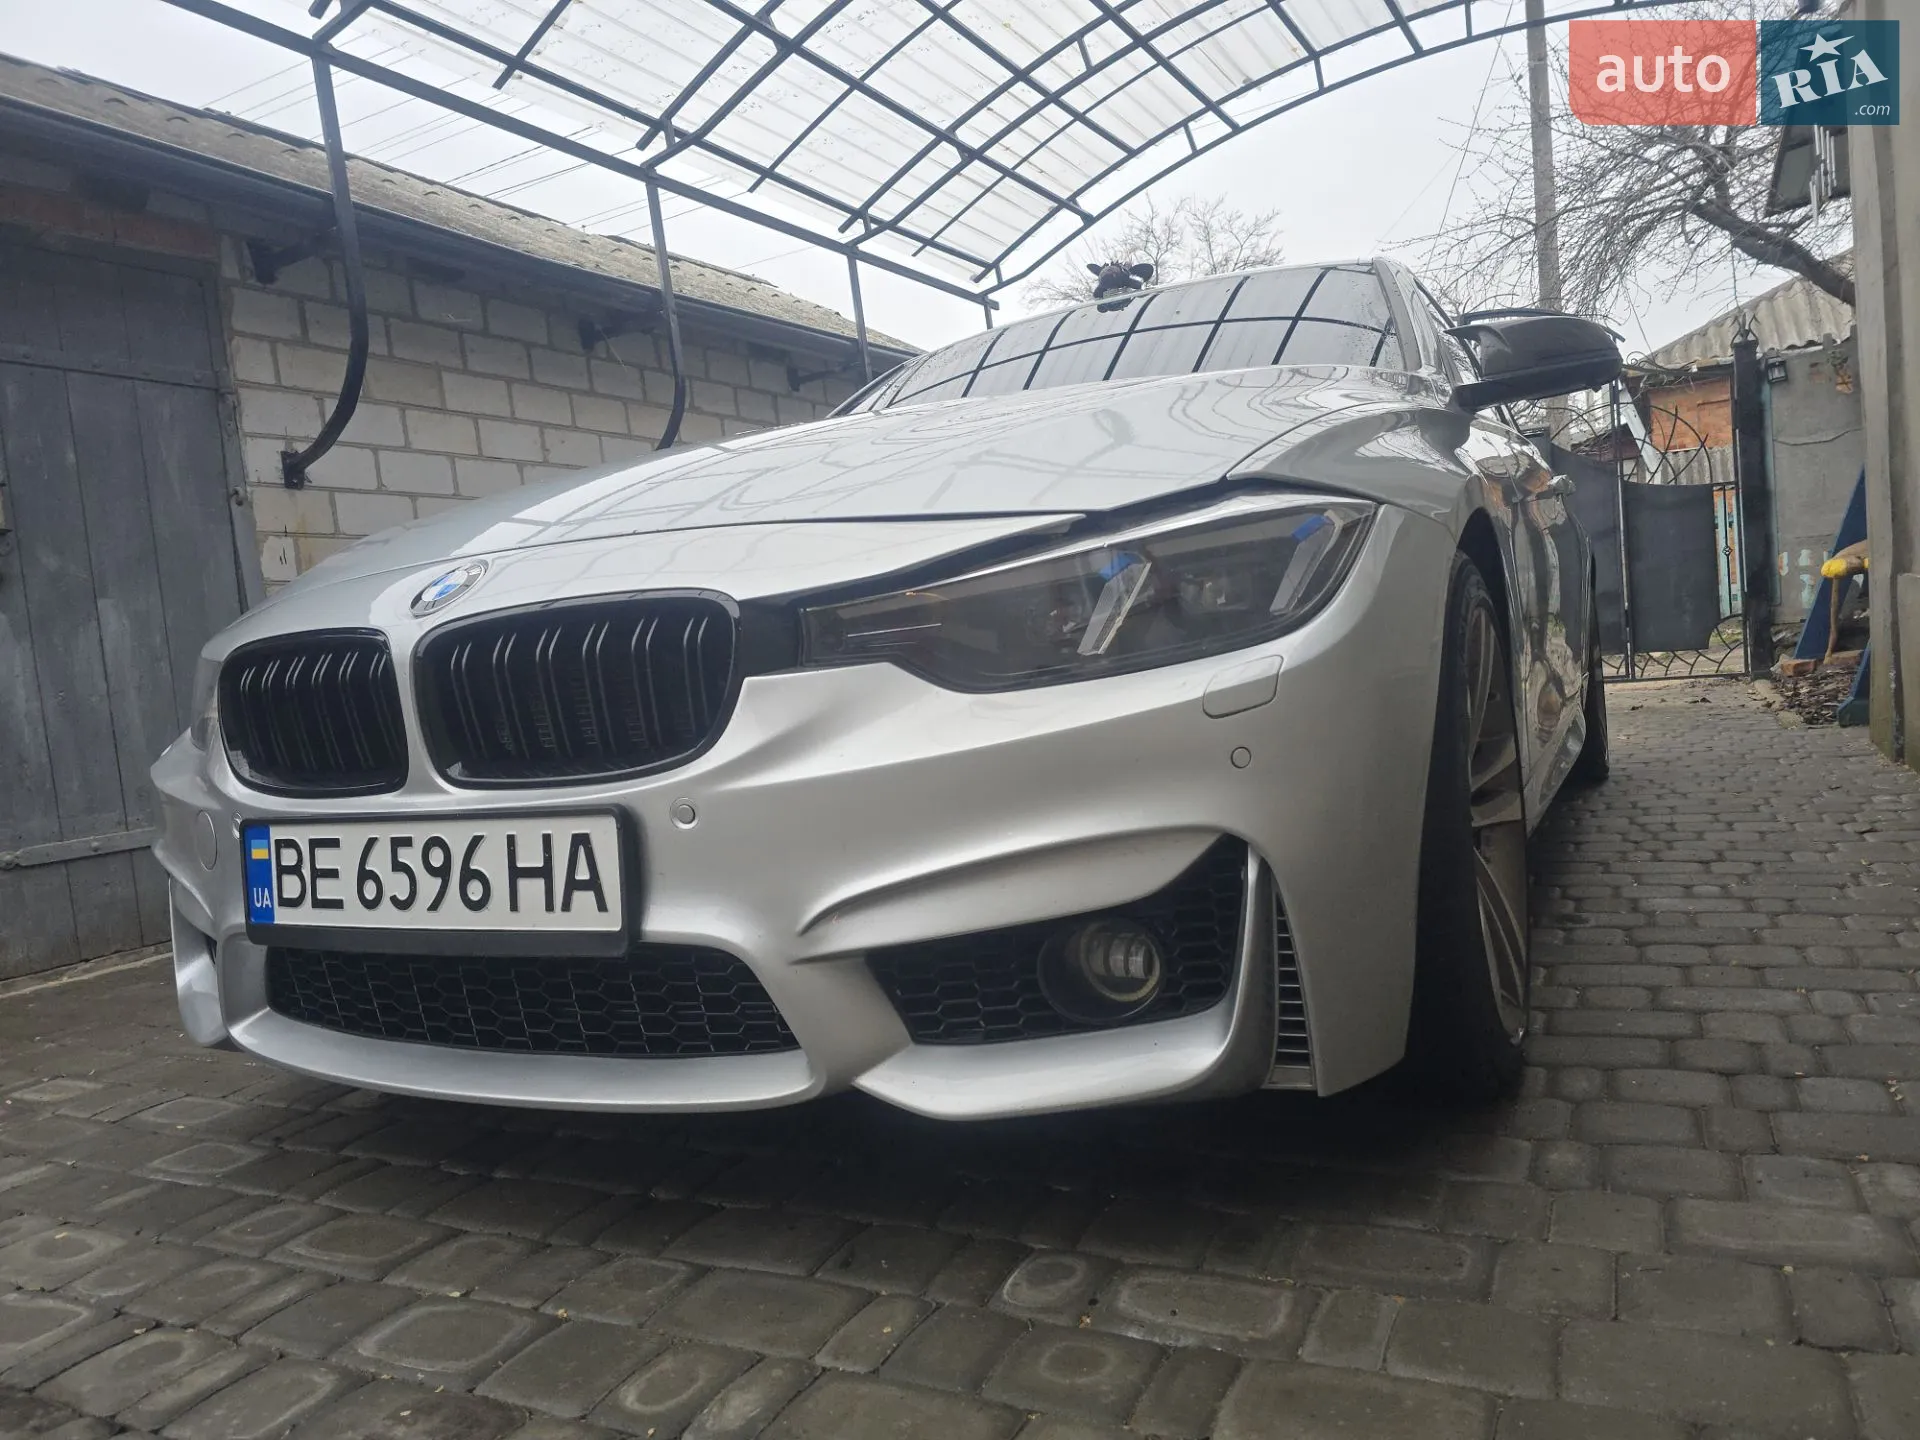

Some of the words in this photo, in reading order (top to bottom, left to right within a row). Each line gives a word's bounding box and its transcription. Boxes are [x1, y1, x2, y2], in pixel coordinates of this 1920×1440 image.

[253, 887, 272, 908] UA
[274, 837, 345, 910] BE
[356, 833, 492, 913] 6596
[506, 832, 609, 913] HA
